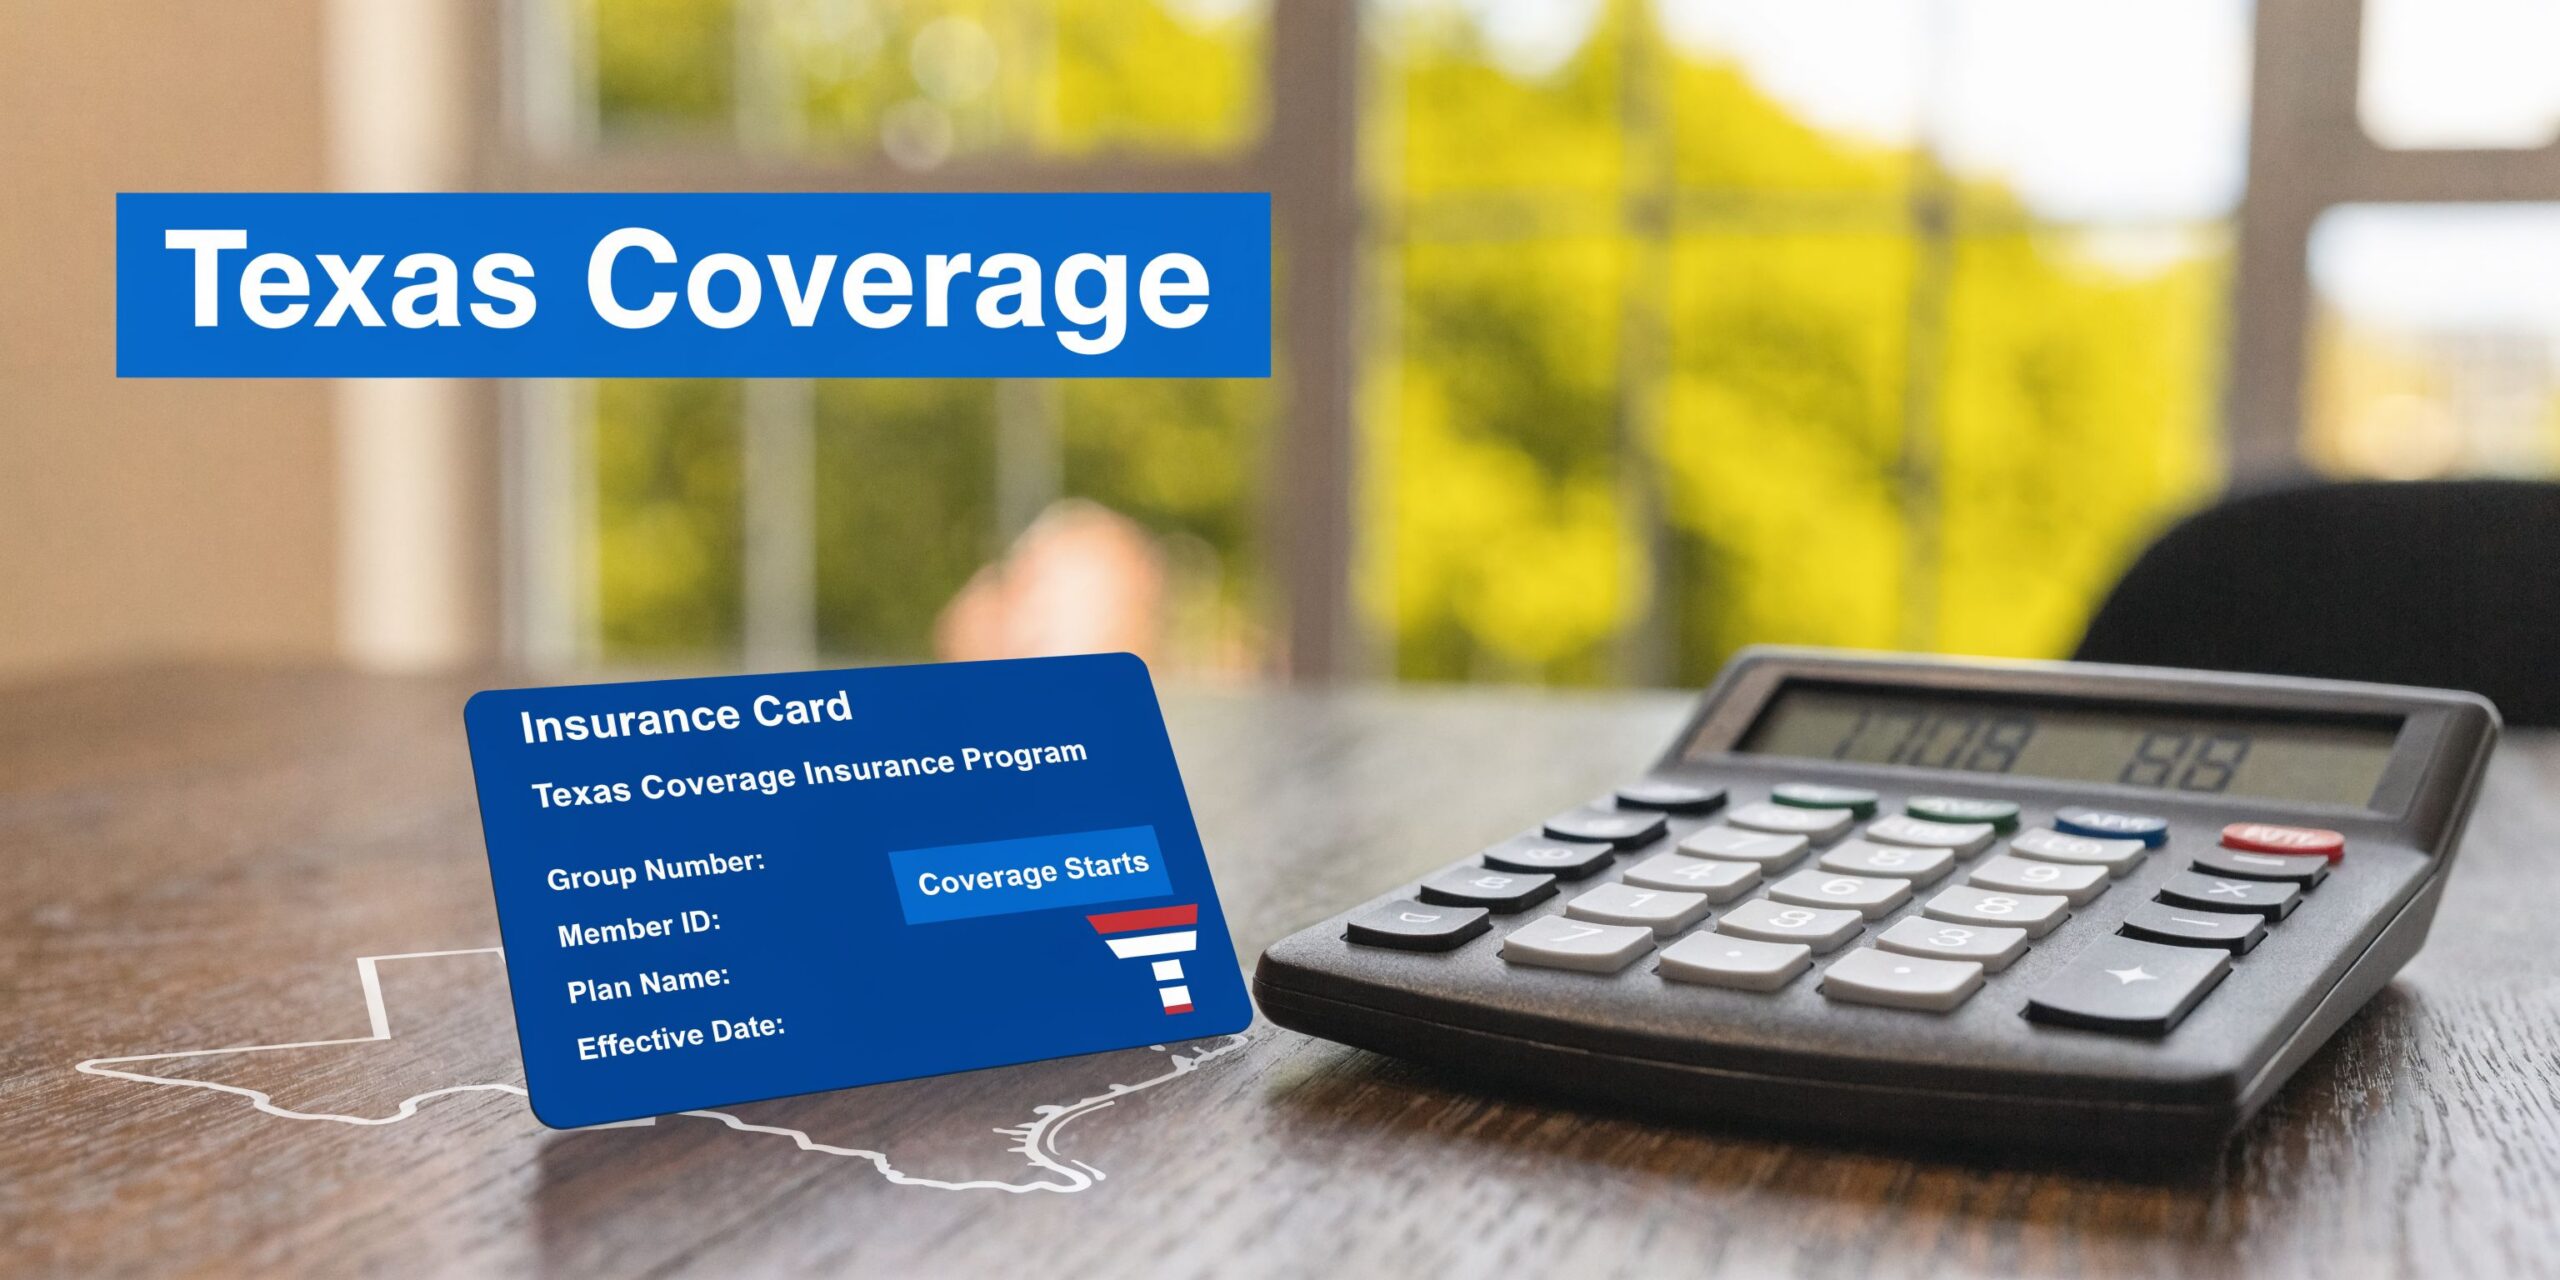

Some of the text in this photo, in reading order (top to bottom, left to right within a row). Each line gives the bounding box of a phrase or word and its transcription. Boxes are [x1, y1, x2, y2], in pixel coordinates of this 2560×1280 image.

[521, 690, 853, 744] Insurance Card
[532, 744, 1088, 809] Texas Coverage Insurance Program
[548, 853, 765, 891] Group Number:
[919, 853, 1150, 896] Coverage Starts
[558, 911, 721, 948] Member ID:
[568, 969, 730, 1004] Plan Name:
[578, 1017, 785, 1061] Effective Date:
